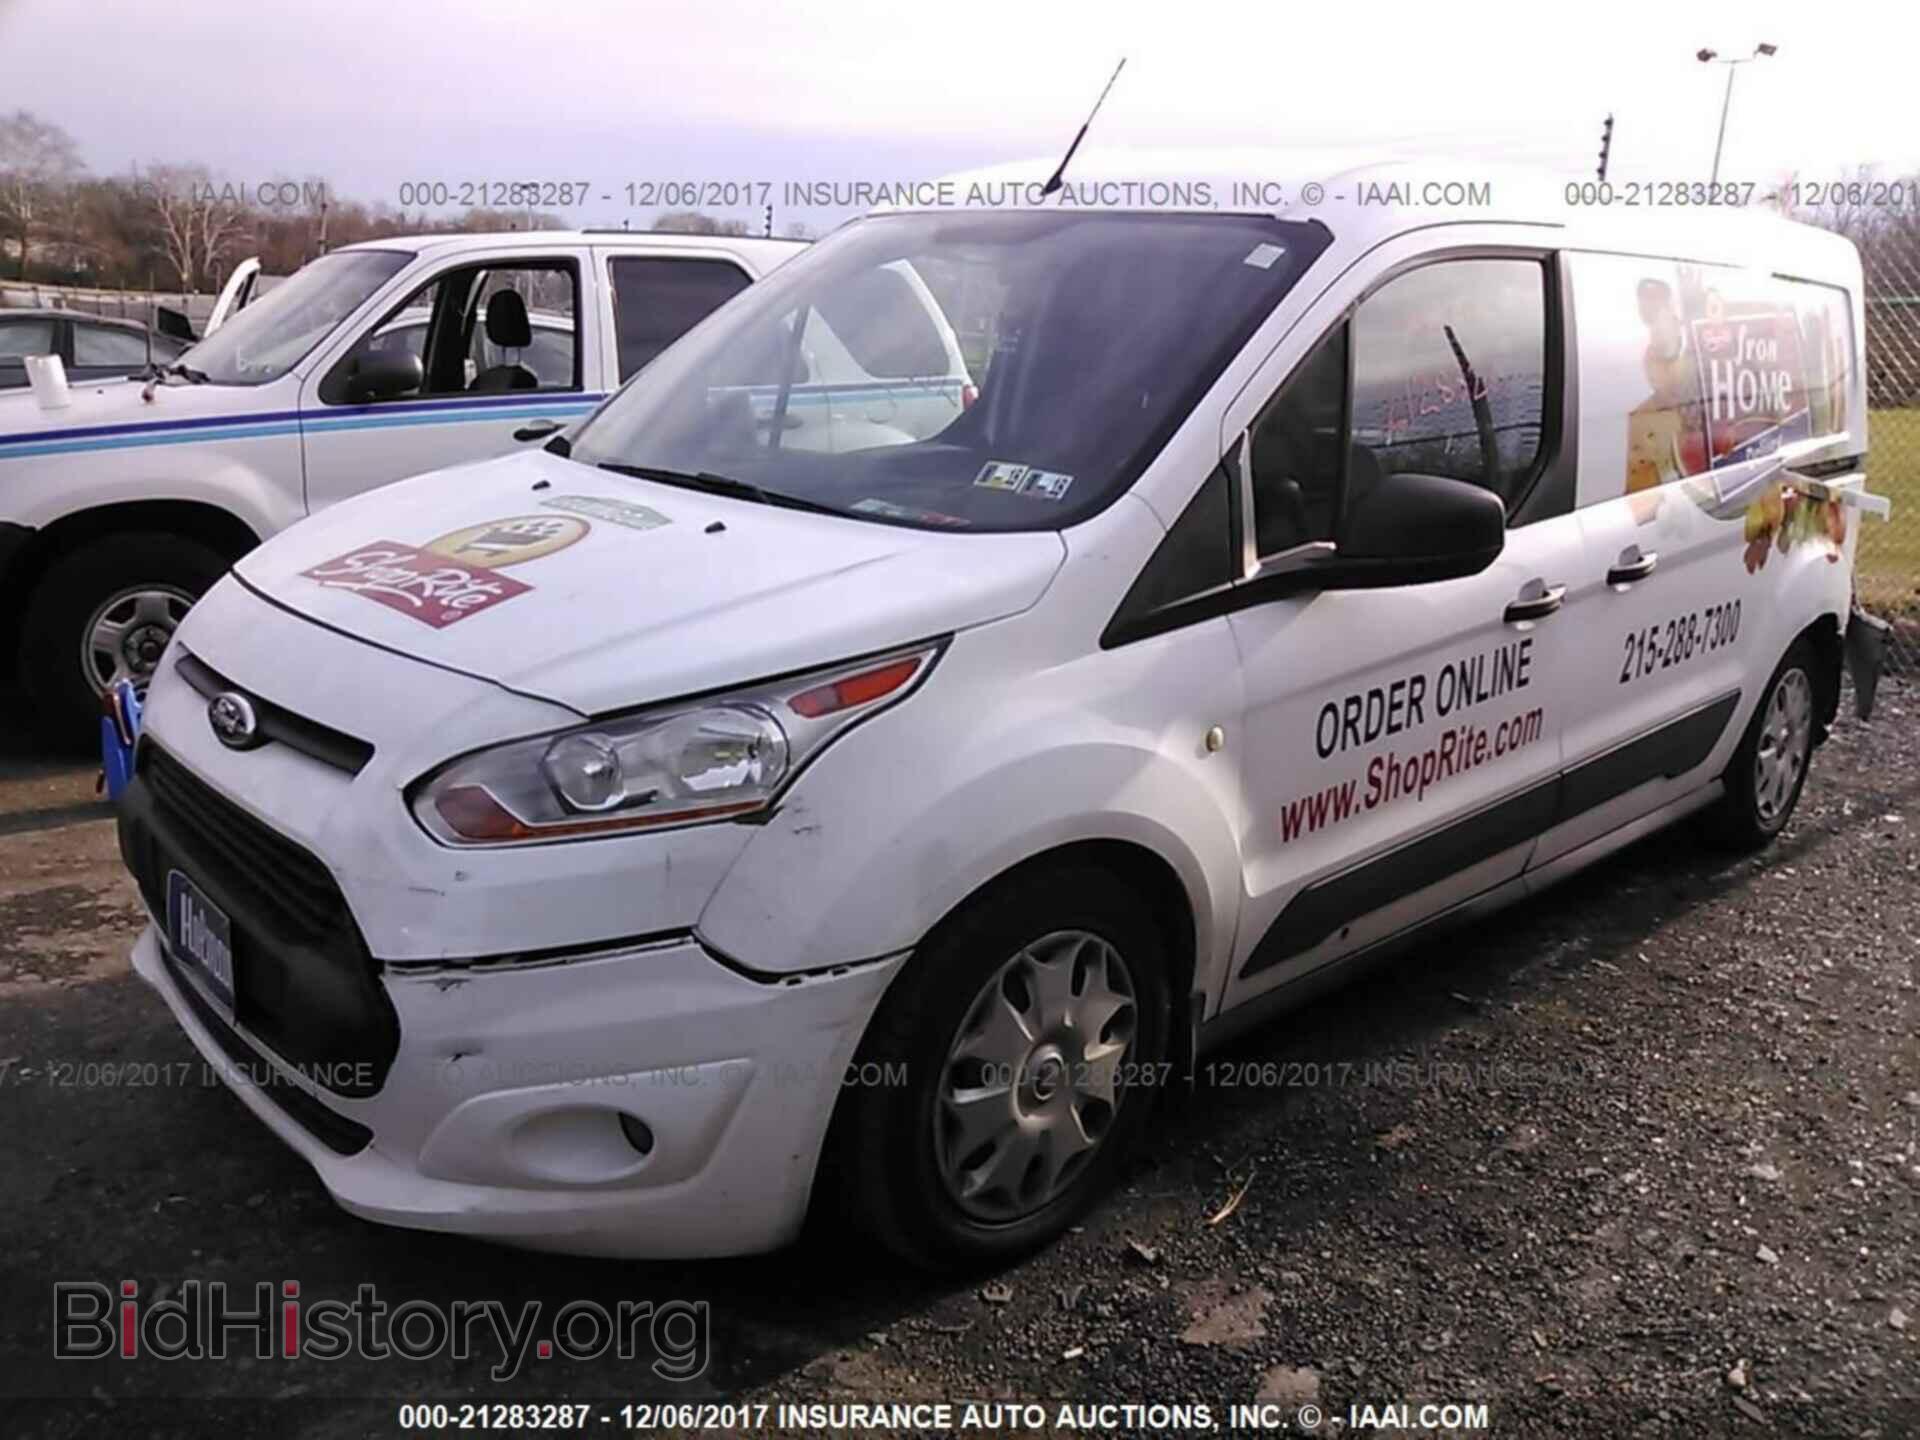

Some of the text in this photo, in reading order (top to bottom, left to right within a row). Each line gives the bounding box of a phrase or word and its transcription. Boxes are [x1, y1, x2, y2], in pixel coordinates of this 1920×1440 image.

[1315, 638, 1533, 759] ORDER ONLINE
[1619, 600, 1741, 684] 215-288-7300
[1281, 707, 1543, 844] www.ShopRite.com
